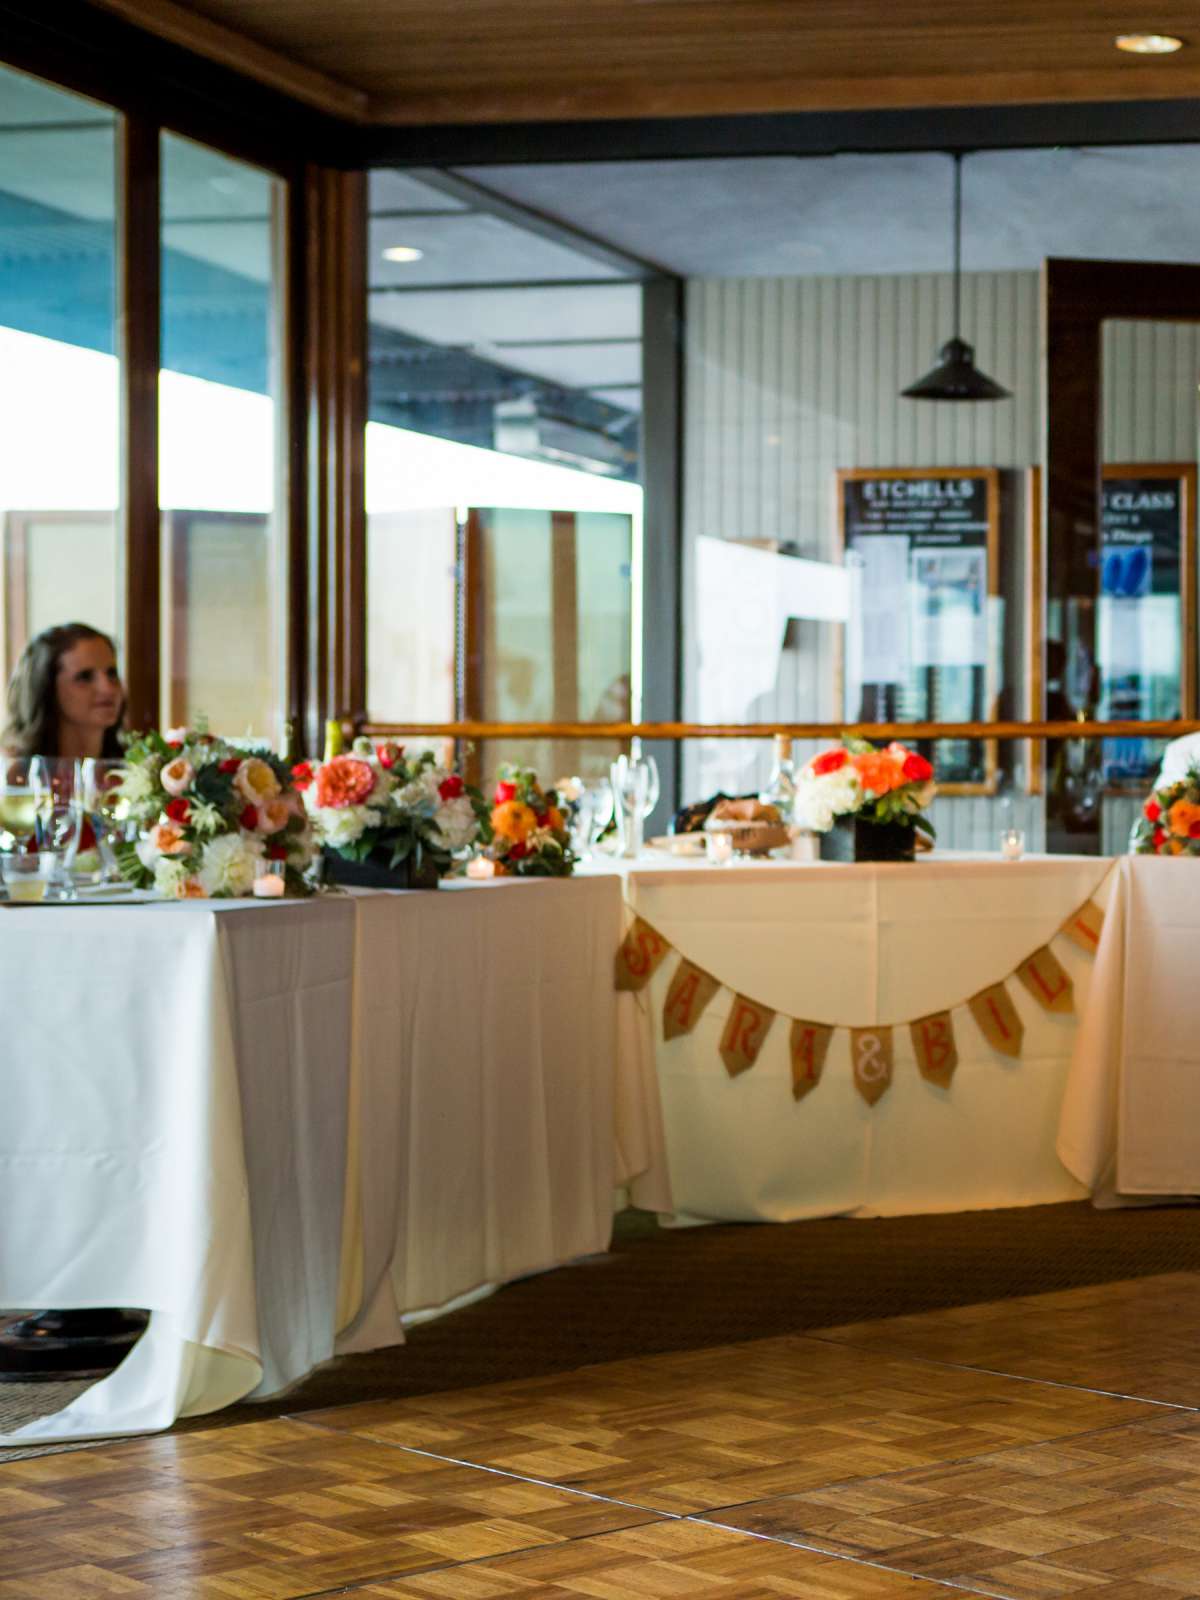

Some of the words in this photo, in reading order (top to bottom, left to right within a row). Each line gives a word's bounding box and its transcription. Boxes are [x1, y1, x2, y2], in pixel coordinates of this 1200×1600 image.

[863, 480, 974, 499] ETCHELLS
[1111, 492, 1175, 511] CLASS
[623, 931, 816, 1080] SARA
[857, 1034, 887, 1083] &
